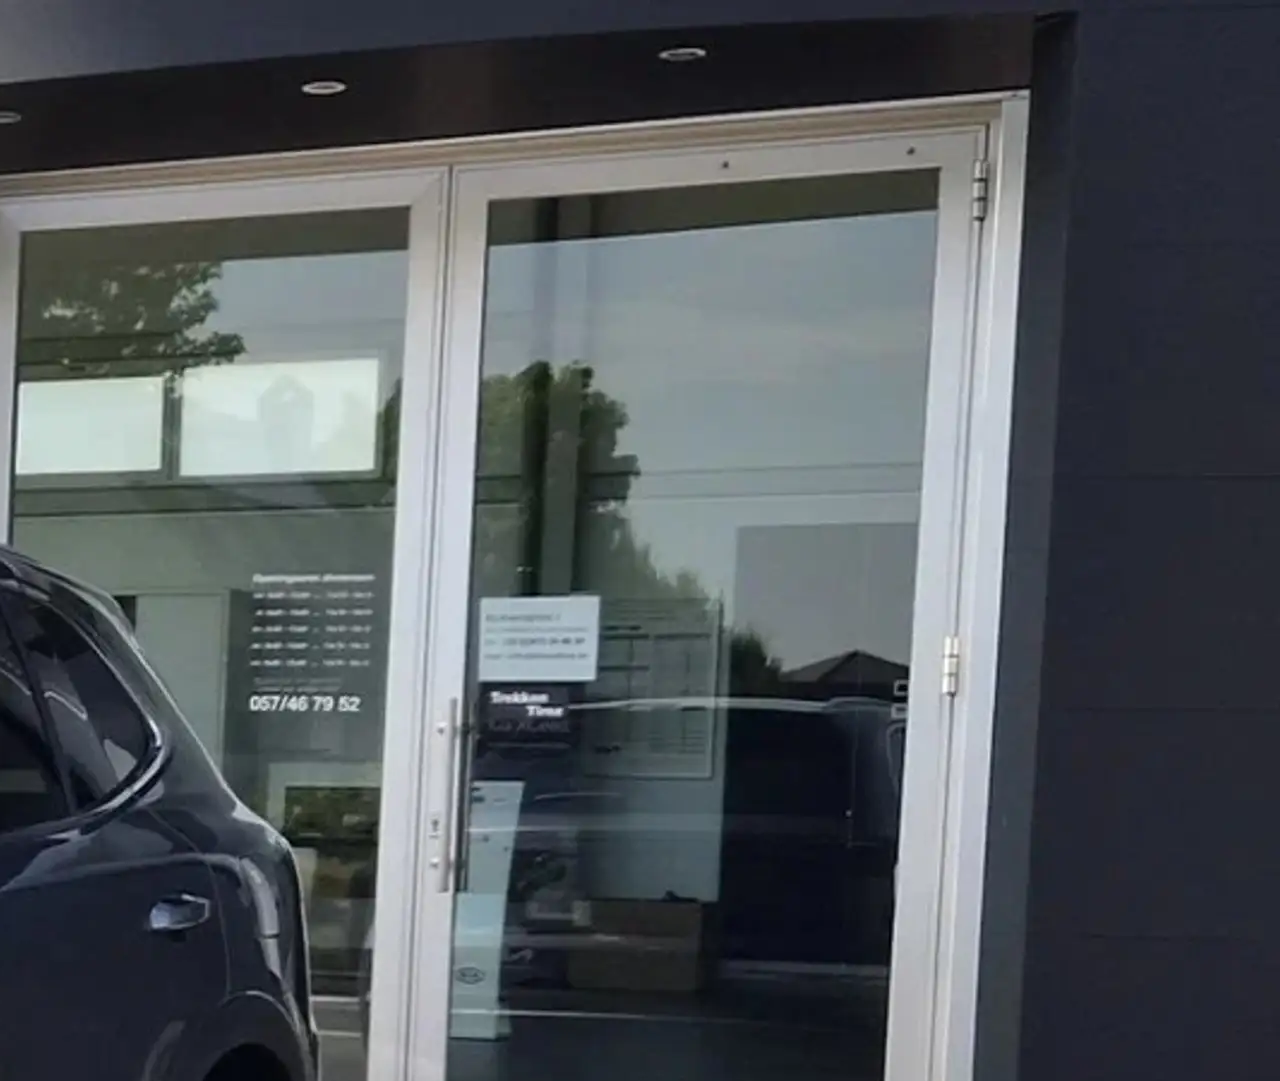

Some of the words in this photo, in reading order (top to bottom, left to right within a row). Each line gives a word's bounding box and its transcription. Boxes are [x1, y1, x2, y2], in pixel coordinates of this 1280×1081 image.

[249, 695, 308, 711] 057/46
[312, 695, 333, 711] 79
[338, 695, 361, 711] 52
